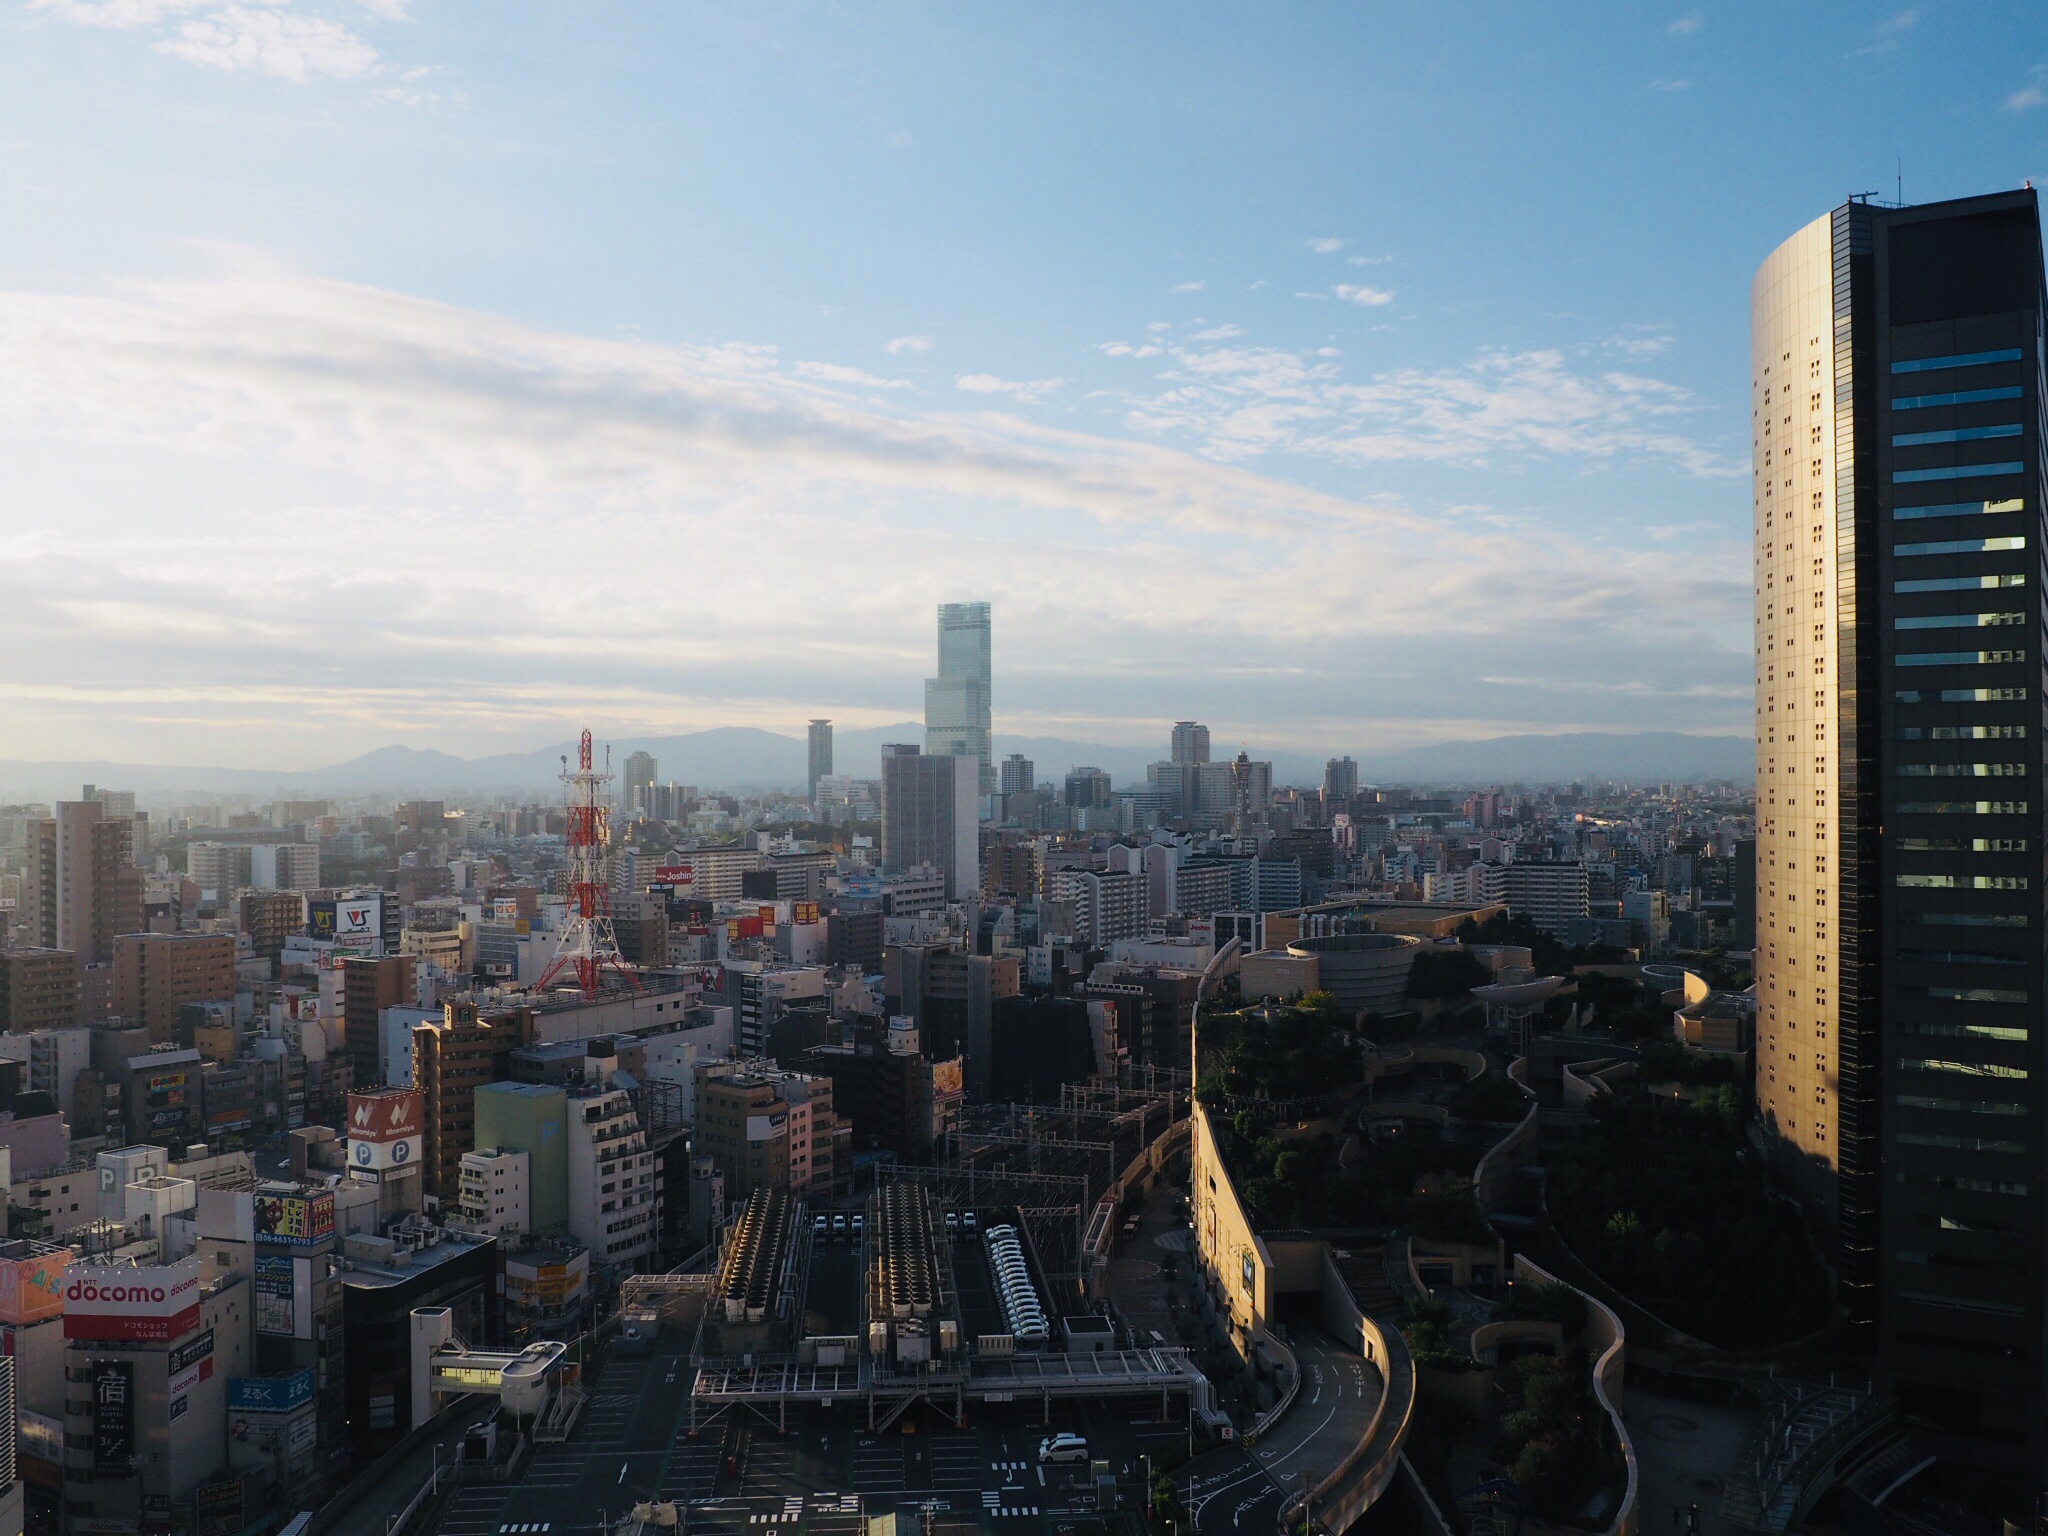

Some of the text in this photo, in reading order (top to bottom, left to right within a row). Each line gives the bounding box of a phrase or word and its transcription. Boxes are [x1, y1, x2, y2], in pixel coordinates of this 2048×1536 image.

[667, 871, 692, 881] Joshin
[350, 1127, 377, 1137] Ninomiya
[386, 1125, 415, 1136] Ninomiya
[396, 1144, 406, 1161] P
[101, 1169, 114, 1190] P
[20, 1262, 63, 1299] DAIS
[171, 1277, 198, 1296] docomo
[67, 1280, 166, 1303] docomo
[124, 1322, 168, 1330] ドコモショップ
[97, 1367, 127, 1404] 宿
[172, 1374, 198, 1394] docomo
[241, 1387, 272, 1400] えるく
[100, 1437, 112, 1446] 3F
[89, 1522, 123, 1531] docomo
